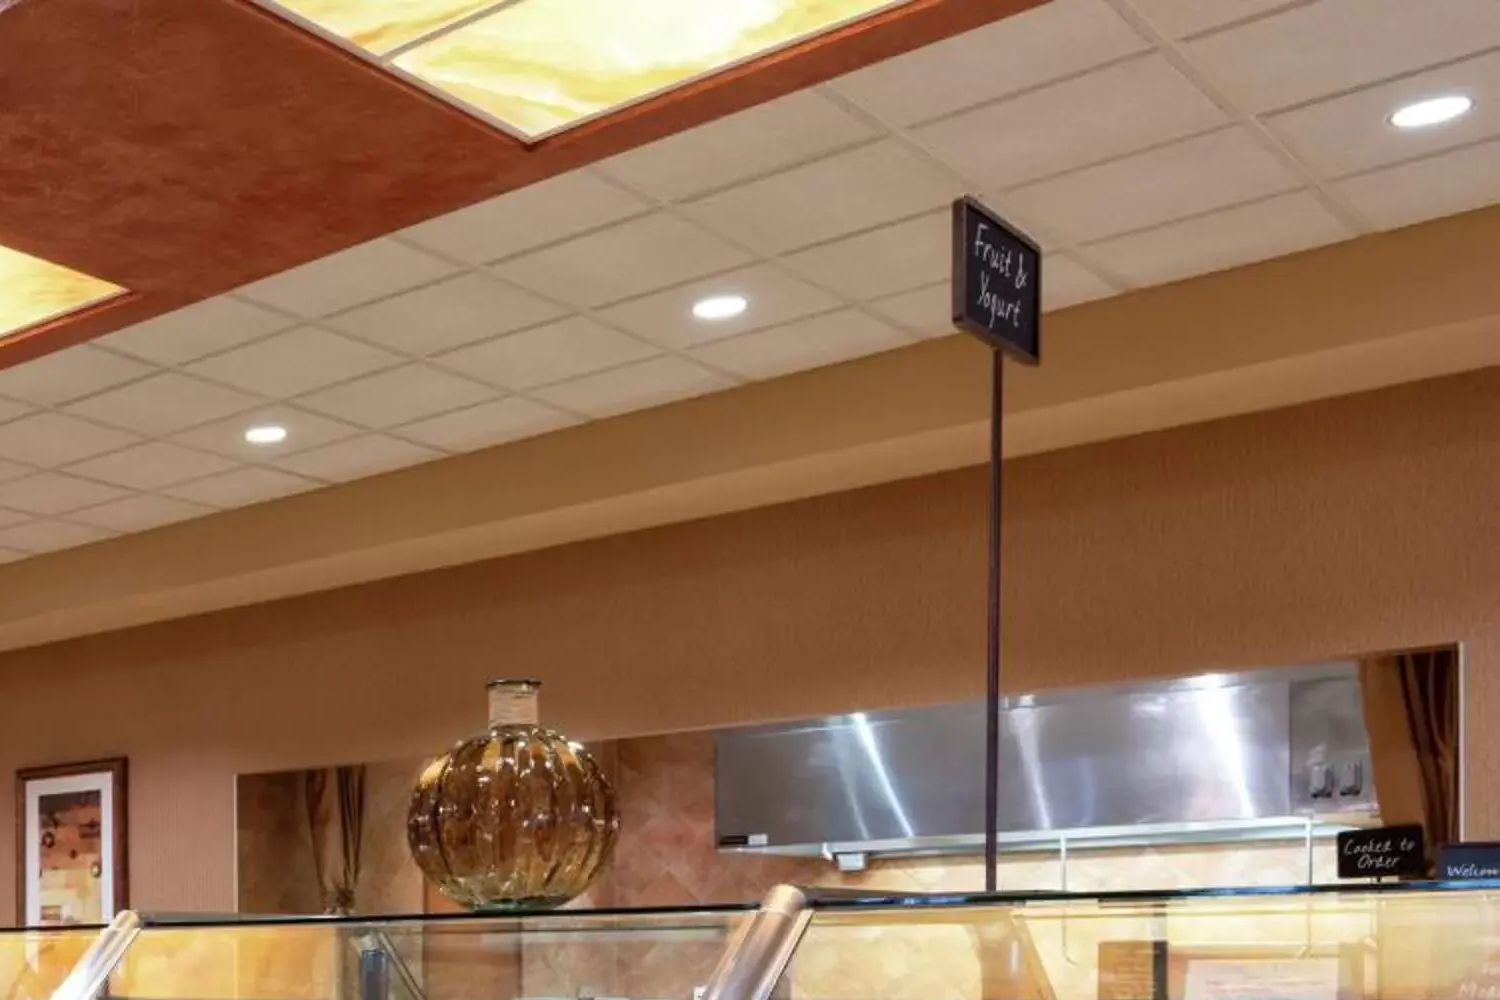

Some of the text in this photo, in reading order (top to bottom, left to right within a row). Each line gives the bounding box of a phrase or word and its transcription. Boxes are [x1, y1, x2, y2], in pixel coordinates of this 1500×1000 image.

[974, 222, 1029, 289] Fruit &
[976, 270, 1021, 329] Yogurt
[1343, 837, 1415, 856] Cooked to
[1357, 853, 1400, 870] Order
[1446, 863, 1500, 877] Welcom
